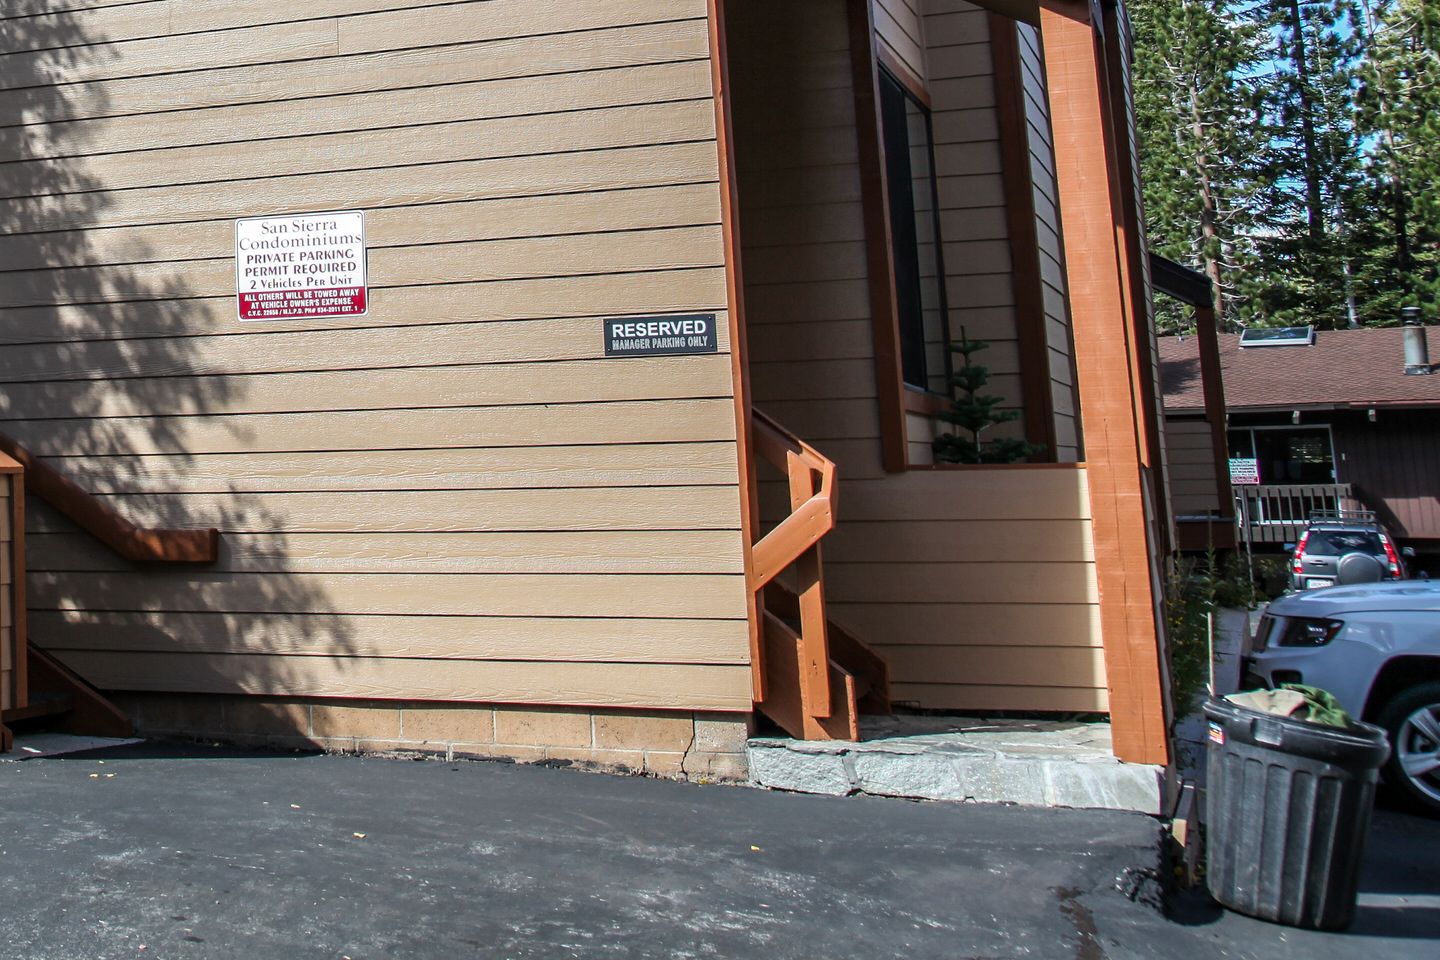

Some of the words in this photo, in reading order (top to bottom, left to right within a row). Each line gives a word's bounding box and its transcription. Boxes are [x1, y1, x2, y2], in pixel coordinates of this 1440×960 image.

[261, 221, 288, 234] San
[292, 218, 337, 233] Sierra
[239, 233, 362, 251] Condominiums
[246, 252, 295, 264] PRIVATE
[299, 249, 354, 262] PARKING
[245, 265, 289, 278] PERMIT
[294, 262, 356, 275] REQUIRED
[250, 280, 257, 290] 2
[244, 293, 257, 302] ALL
[258, 292, 284, 301] OTHERS
[285, 291, 302, 300] WILL
[304, 290, 312, 298] BE
[314, 289, 338, 298] TOWED
[340, 288, 360, 297] AWAY
[251, 301, 260, 310] AT
[260, 300, 288, 309] VEHICLE
[290, 298, 320, 308] OWNER'S
[322, 297, 354, 306] EXPENSE.
[612, 320, 706, 338] RESERVED
[612, 338, 650, 351] MANAGER
[652, 336, 686, 349] PARKING
[688, 336, 708, 347] ONLY
